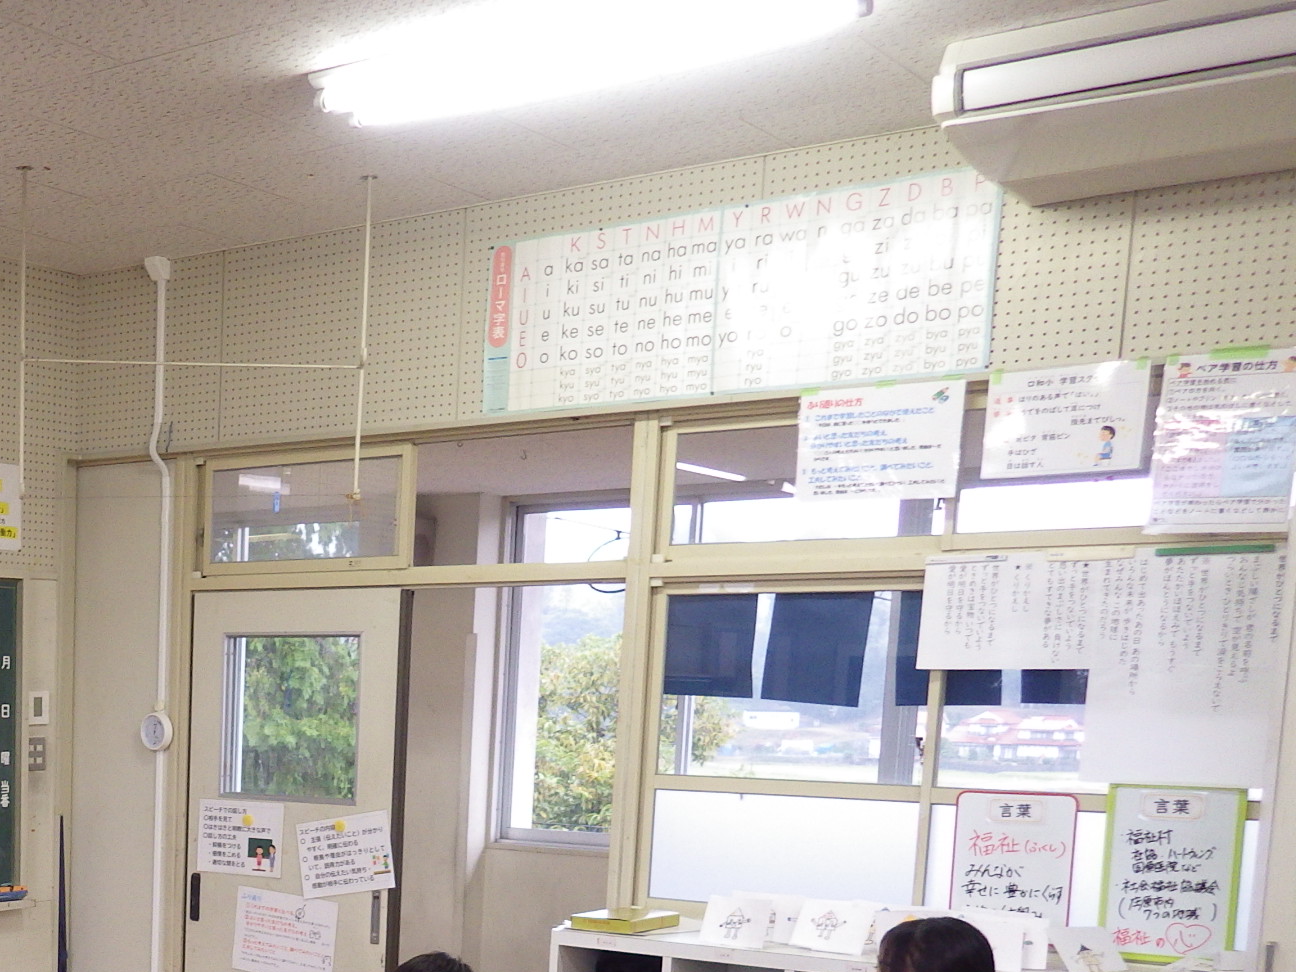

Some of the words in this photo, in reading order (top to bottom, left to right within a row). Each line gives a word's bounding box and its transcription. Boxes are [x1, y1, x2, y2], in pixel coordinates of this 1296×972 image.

[571, 236, 581, 251] K
[597, 233, 606, 249] S
[622, 229, 632, 244] T
[646, 226, 660, 241] N
[672, 220, 685, 236] H
[698, 217, 714, 233] M
[733, 211, 743, 227] Y
[761, 207, 771, 224] R
[786, 202, 804, 219] W
[817, 197, 831, 215] N
[846, 193, 863, 211] G
[879, 188, 891, 206] Z
[908, 183, 922, 201] D
[941, 179, 953, 195] B
[520, 267, 530, 281] A
[544, 264, 553, 276] a
[565, 258, 583, 273] ka
[592, 257, 609, 270] sa
[618, 252, 633, 266] ta
[642, 249, 661, 263] na
[668, 243, 687, 258] ha
[692, 240, 717, 254] ma
[725, 236, 746, 255] ya
[755, 232, 773, 245] ra
[545, 284, 550, 297] i
[567, 280, 579, 294] ki
[593, 278, 604, 292] si
[620, 275, 629, 288] ti
[644, 271, 656, 284] ni
[669, 266, 682, 280] hi
[492, 275, 506, 338] ローマ字表
[519, 310, 528, 325] U
[543, 308, 551, 320] u
[563, 301, 580, 317] ku
[589, 302, 605, 314] su
[616, 298, 630, 311] tu
[639, 295, 657, 308] nu
[665, 289, 683, 303] hu
[690, 286, 712, 301] mu
[520, 331, 526, 347] E
[541, 330, 549, 342] e
[562, 323, 579, 338] ke
[587, 323, 604, 336] se
[614, 320, 628, 333] te
[638, 317, 656, 330] ne
[663, 312, 682, 327] he
[688, 311, 712, 324] me
[928, 280, 952, 297] be
[516, 353, 527, 368] O
[540, 351, 549, 363] o
[559, 346, 577, 361] ko
[585, 346, 603, 359] so
[612, 343, 627, 355] to
[635, 339, 654, 352] no
[661, 333, 681, 348] ho
[687, 332, 712, 346] mo
[718, 331, 737, 348] yo
[833, 317, 857, 336] go
[864, 315, 887, 329] zo
[894, 308, 918, 325] do
[925, 304, 951, 321] bo
[958, 303, 984, 323] po
[1197, 361, 1278, 372] ペア学習の仕方
[1, 655, 11, 670] 月
[1, 704, 10, 718] 日
[0, 780, 10, 808] 当番
[1154, 799, 1190, 815] 言葉
[999, 803, 1032, 818] 言葉
[965, 864, 1024, 878] みんなが
